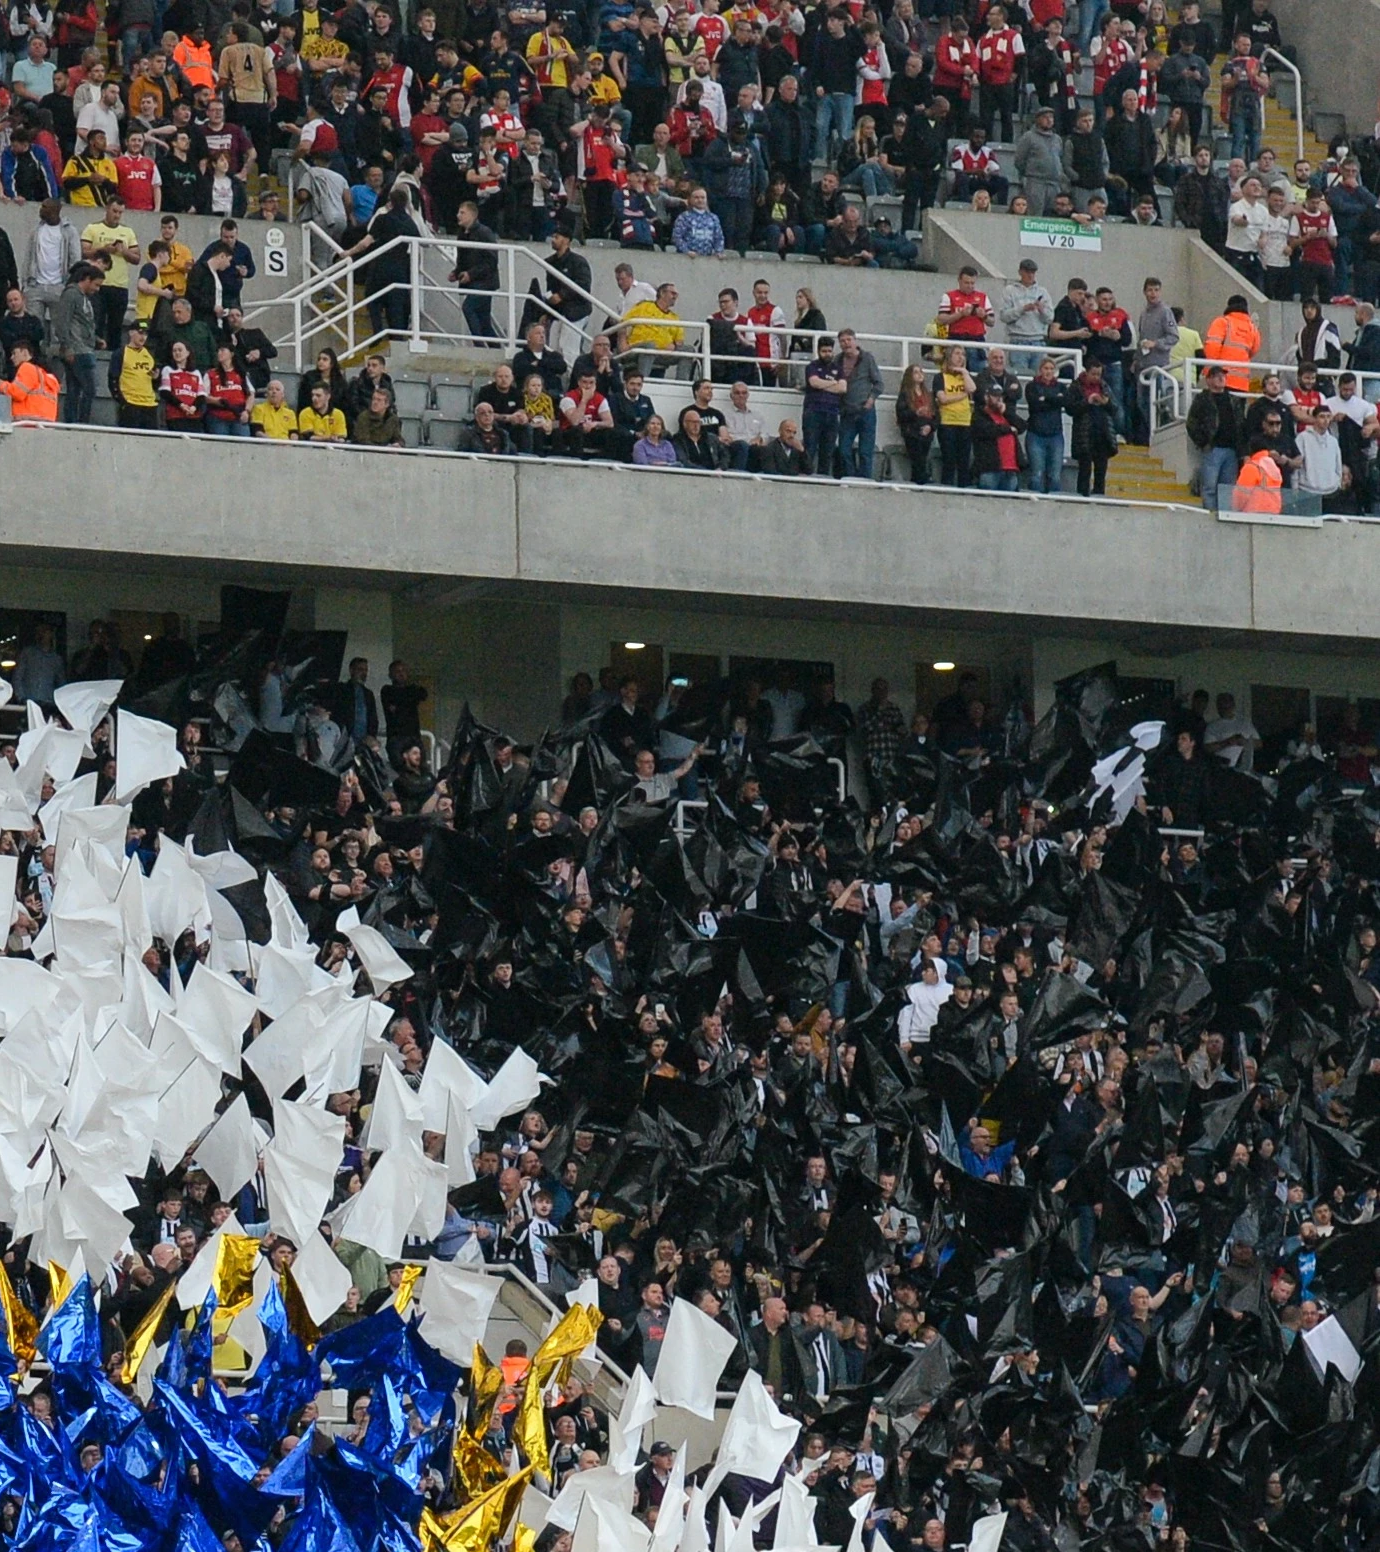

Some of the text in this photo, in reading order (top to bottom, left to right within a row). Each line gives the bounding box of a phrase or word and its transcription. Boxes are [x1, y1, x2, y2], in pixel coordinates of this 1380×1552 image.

[243, 54, 254, 73] 4
[127, 170, 147, 180] JVC
[1024, 219, 1077, 234] Emergency
[1048, 235, 1075, 248] V 20
[269, 250, 284, 272] S
